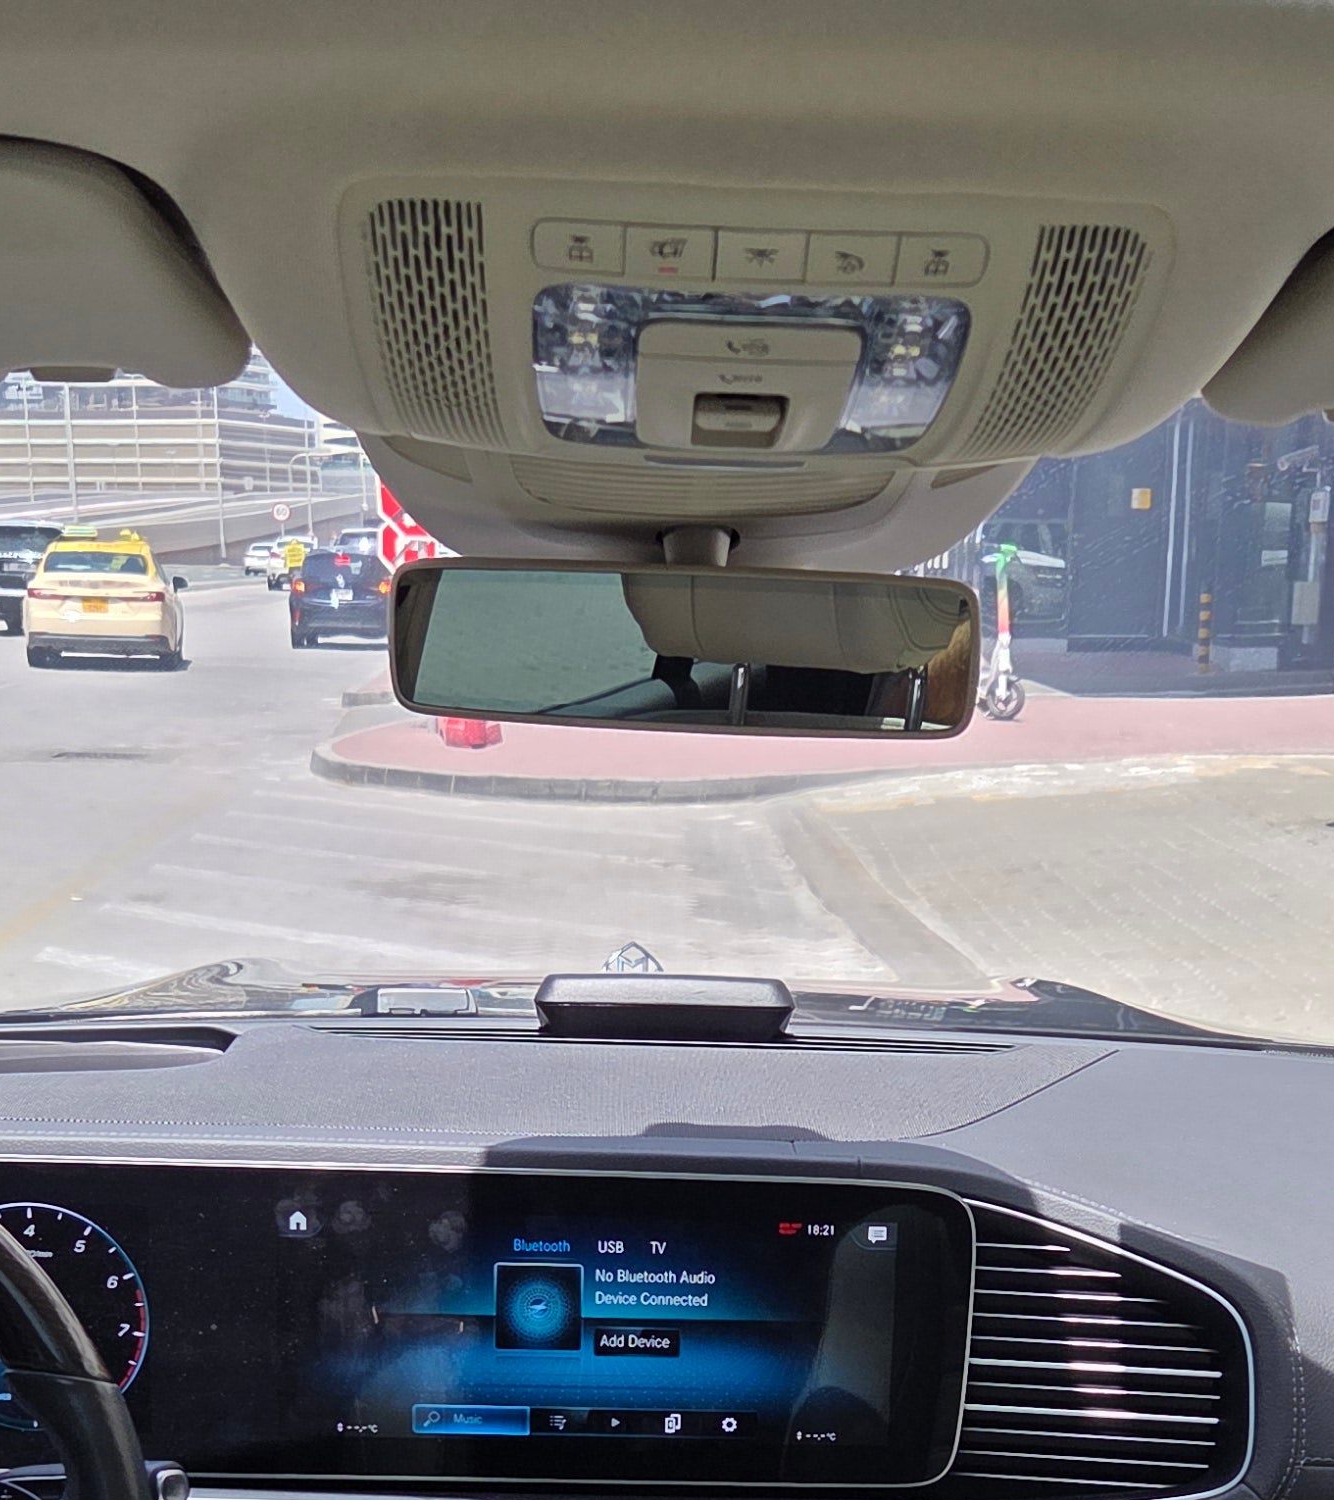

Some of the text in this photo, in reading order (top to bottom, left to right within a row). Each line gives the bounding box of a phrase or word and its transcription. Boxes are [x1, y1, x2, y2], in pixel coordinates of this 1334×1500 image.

[23, 1224, 36, 1237] 4
[807, 1224, 835, 1236] 18:21
[74, 1239, 86, 1253] 5
[513, 1238, 666, 1254] Bluetooth USB TV
[106, 1275, 119, 1289] 6
[595, 1268, 716, 1285] No Bluetooth Audio
[595, 1291, 708, 1307] Device Connected
[117, 1323, 130, 1337] 7
[599, 1334, 671, 1349] Add Device
[453, 1414, 483, 1425] Music
